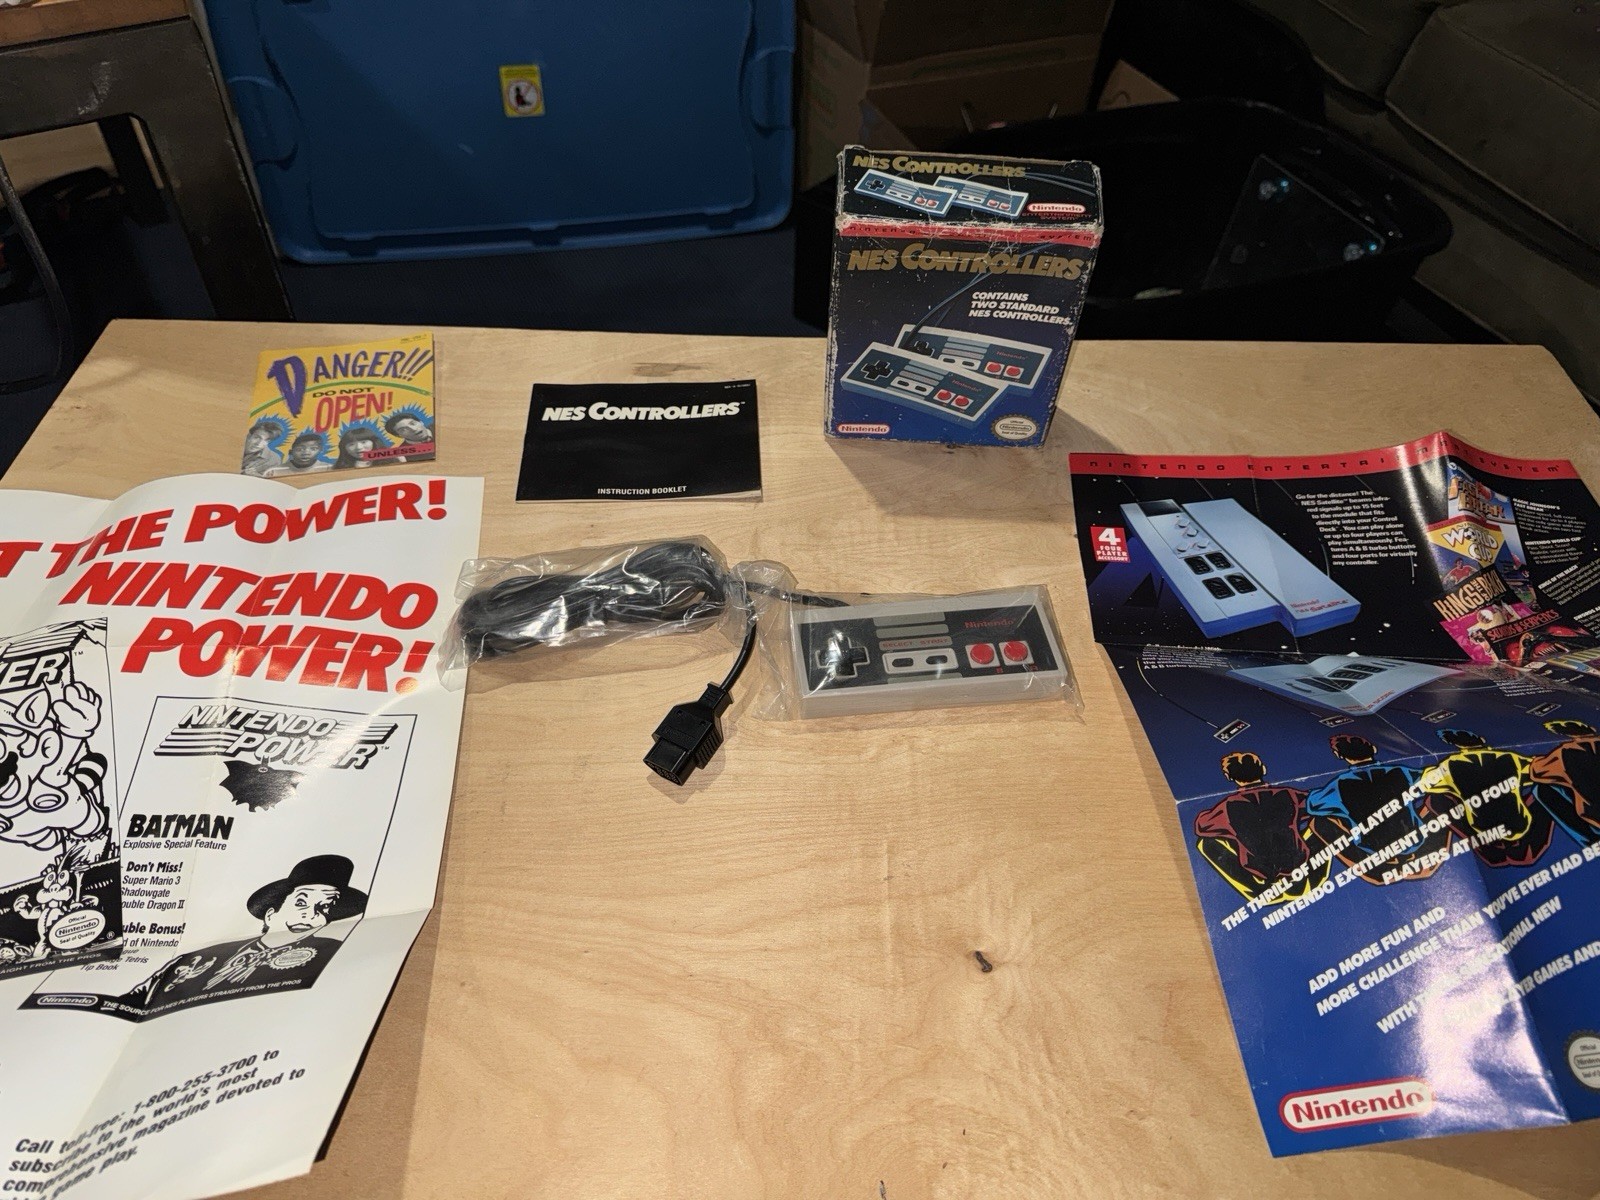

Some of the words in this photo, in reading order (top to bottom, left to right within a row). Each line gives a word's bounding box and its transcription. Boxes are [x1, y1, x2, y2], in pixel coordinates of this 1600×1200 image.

[853, 155, 890, 170] NES
[892, 156, 1027, 178] CONTROLLERS
[1031, 204, 1083, 213] Nintendo
[847, 249, 899, 271] NES
[901, 243, 1085, 280] CONTROLLERS
[972, 291, 1029, 302] CONTAINS
[968, 309, 991, 318] NES
[970, 301, 998, 310] TWO
[999, 302, 1060, 315] STANDARD
[313, 389, 336, 398] DO
[339, 387, 374, 396] NOT
[315, 391, 394, 433] OPEN!
[542, 406, 587, 422] NES
[588, 401, 741, 421] CONTROLLERS
[841, 424, 888, 434] Nintendo
[1089, 460, 1225, 471] NINTENDO
[652, 485, 687, 494] BOOKLET
[46, 508, 174, 580] THE
[184, 479, 448, 544] POWER!
[1098, 528, 1121, 546] 4
[58, 562, 439, 630] NINTENDO
[1433, 583, 1485, 622] KINGS
[964, 619, 1014, 630] Nintendo
[882, 640, 914, 648] SELECT
[121, 617, 435, 695] POWER!
[178, 704, 339, 737] NINTENDO
[226, 731, 379, 770] POWR
[126, 813, 234, 841] BATMAN
[123, 840, 162, 850] Explosive
[164, 839, 193, 850] Special
[195, 839, 227, 851] Feature
[1261, 880, 1336, 930] NINTENDO
[1337, 831, 1421, 887] EXCITEMENT
[1419, 814, 1452, 839] FOR
[1449, 804, 1465, 820] UP
[1464, 795, 1482, 811] TO
[1481, 776, 1519, 804] FOUR
[126, 861, 154, 872] Don't
[157, 861, 183, 872] Miss!
[1221, 906, 1250, 932] THE
[1248, 880, 1294, 915] THRILL
[1291, 865, 1311, 884] OF
[1312, 797, 1403, 872] MULTI-PLAYER
[1381, 847, 1451, 886] PLAYERS
[1452, 838, 1471, 857] AT
[1471, 836, 1480, 850] A
[122, 875, 148, 887] Super
[150, 876, 173, 885] Mario
[174, 876, 181, 885] 3
[122, 899, 145, 909] ouble
[147, 900, 176, 911] Dragon
[58, 921, 97, 936] Nintendo
[78, 931, 96, 941] Quality
[149, 922, 186, 935] Bonus!
[1316, 986, 1360, 1017] MORE
[1358, 936, 1443, 990] CHALLENGE
[1439, 910, 1485, 946] THAN
[1482, 886, 1521, 921] YOU'VE
[1518, 869, 1552, 896] EVER
[1550, 853, 1583, 878] HAD
[130, 938, 139, 947] of
[140, 938, 179, 947] Nintendo
[1308, 968, 1339, 995] ADD
[1338, 945, 1383, 976] MORE
[1380, 924, 1414, 954] FUN
[1412, 905, 1447, 936] AND
[30, 961, 56, 970] FROM
[125, 956, 149, 964] Tetris
[1376, 996, 1418, 1035] WITH
[1533, 895, 1562, 924] NEW
[1533, 955, 1574, 985] GAMES
[1573, 941, 1600, 965] AND
[42, 996, 93, 1004] Nintendo
[119, 1004, 150, 1016] SOURCE
[150, 1005, 164, 1013] FOR
[178, 994, 208, 1005] PLAYERS
[208, 987, 244, 998] STRAIGHT
[245, 983, 266, 992] FROM
[15, 1139, 54, 1153] Call
[59, 1111, 125, 1154] toll-free:
[134, 1055, 258, 1113] 1-800-255-3700
[263, 1050, 280, 1062] to
[1291, 1089, 1424, 1123] Nintendo
[3, 1137, 128, 1194] comprehensive
[132, 1100, 210, 1143] magazine
[215, 1073, 284, 1104] devoted
[289, 1068, 306, 1080] to
[9, 1143, 91, 1173] subscribe
[97, 1130, 113, 1145] to
[119, 1114, 145, 1135] the
[152, 1086, 210, 1118] world's
[217, 1067, 258, 1090] most
[51, 1166, 95, 1200] game
